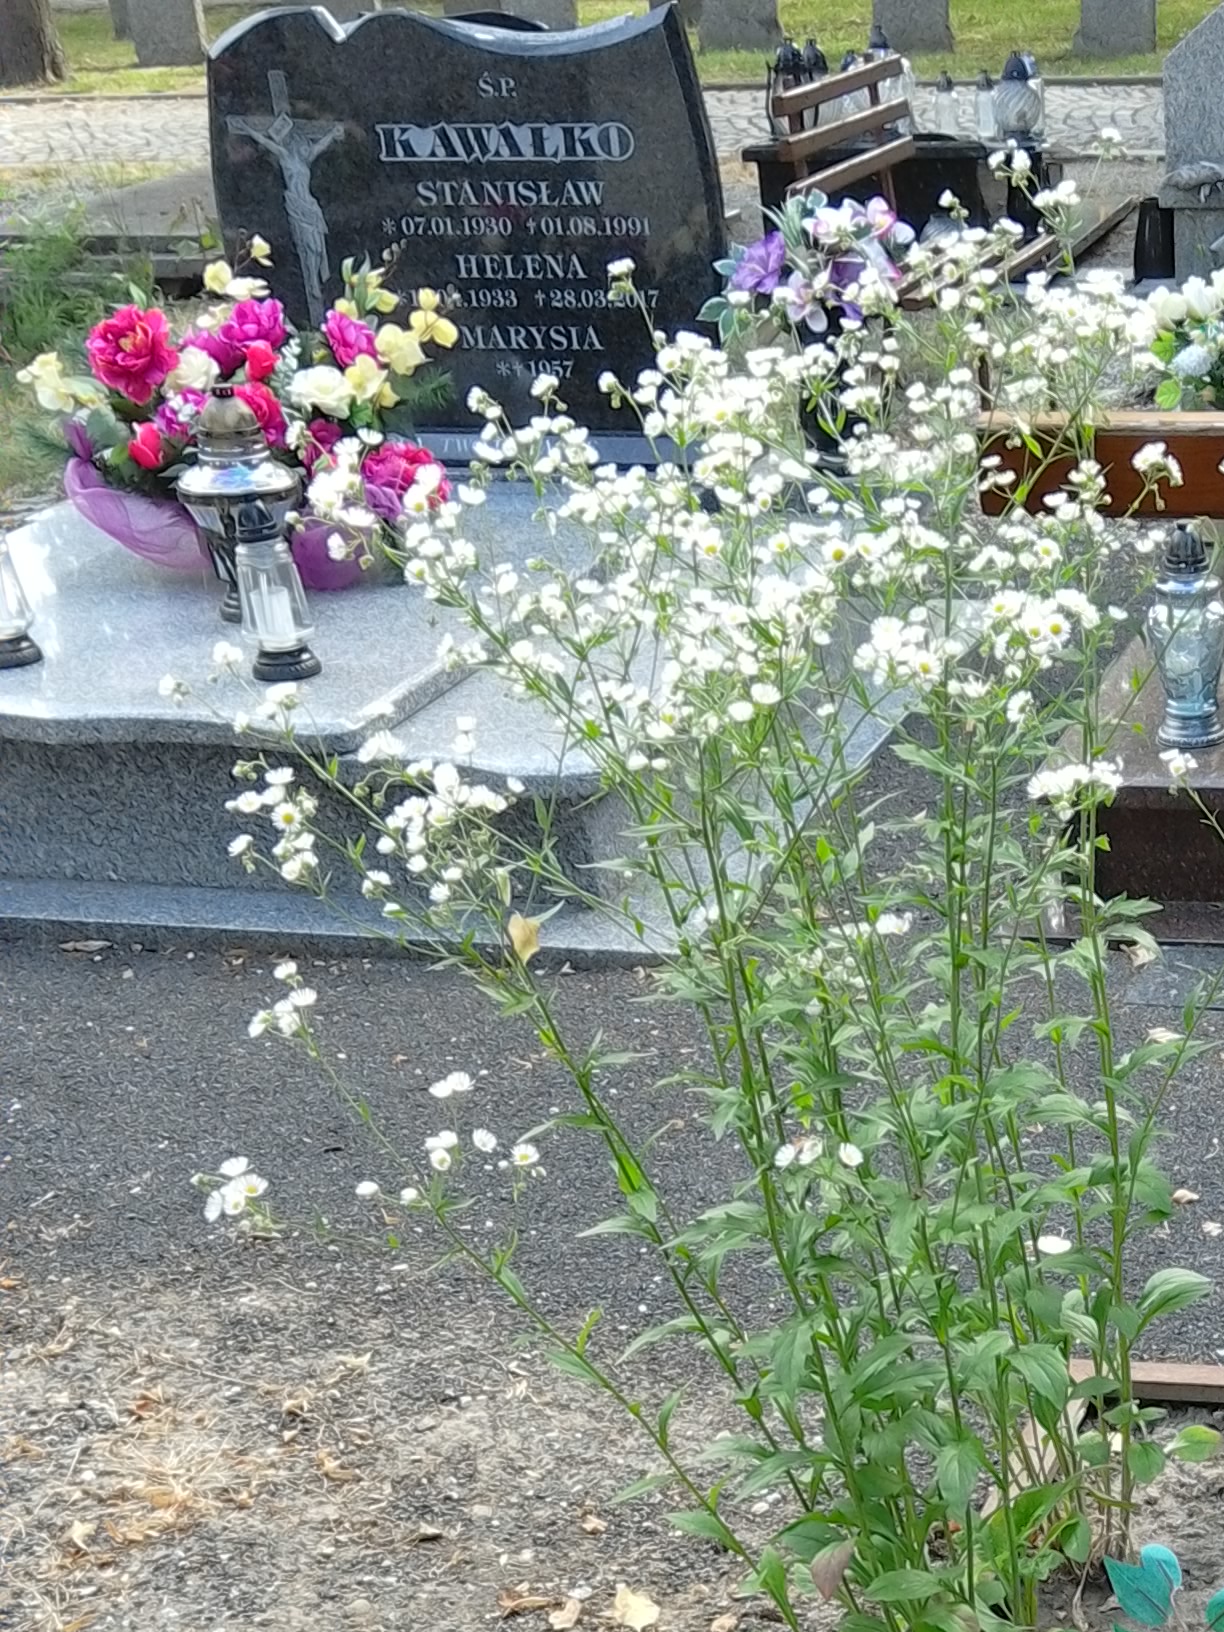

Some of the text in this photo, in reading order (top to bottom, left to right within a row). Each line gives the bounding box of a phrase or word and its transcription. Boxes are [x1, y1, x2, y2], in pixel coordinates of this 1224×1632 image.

[375, 121, 634, 163] KAWAŁKO
[416, 179, 605, 207] STANISŁAW
[401, 216, 652, 236] 07.01.1930 01.08.1991
[456, 254, 588, 280] HELENA
[460, 325, 605, 351] MARYSIA
